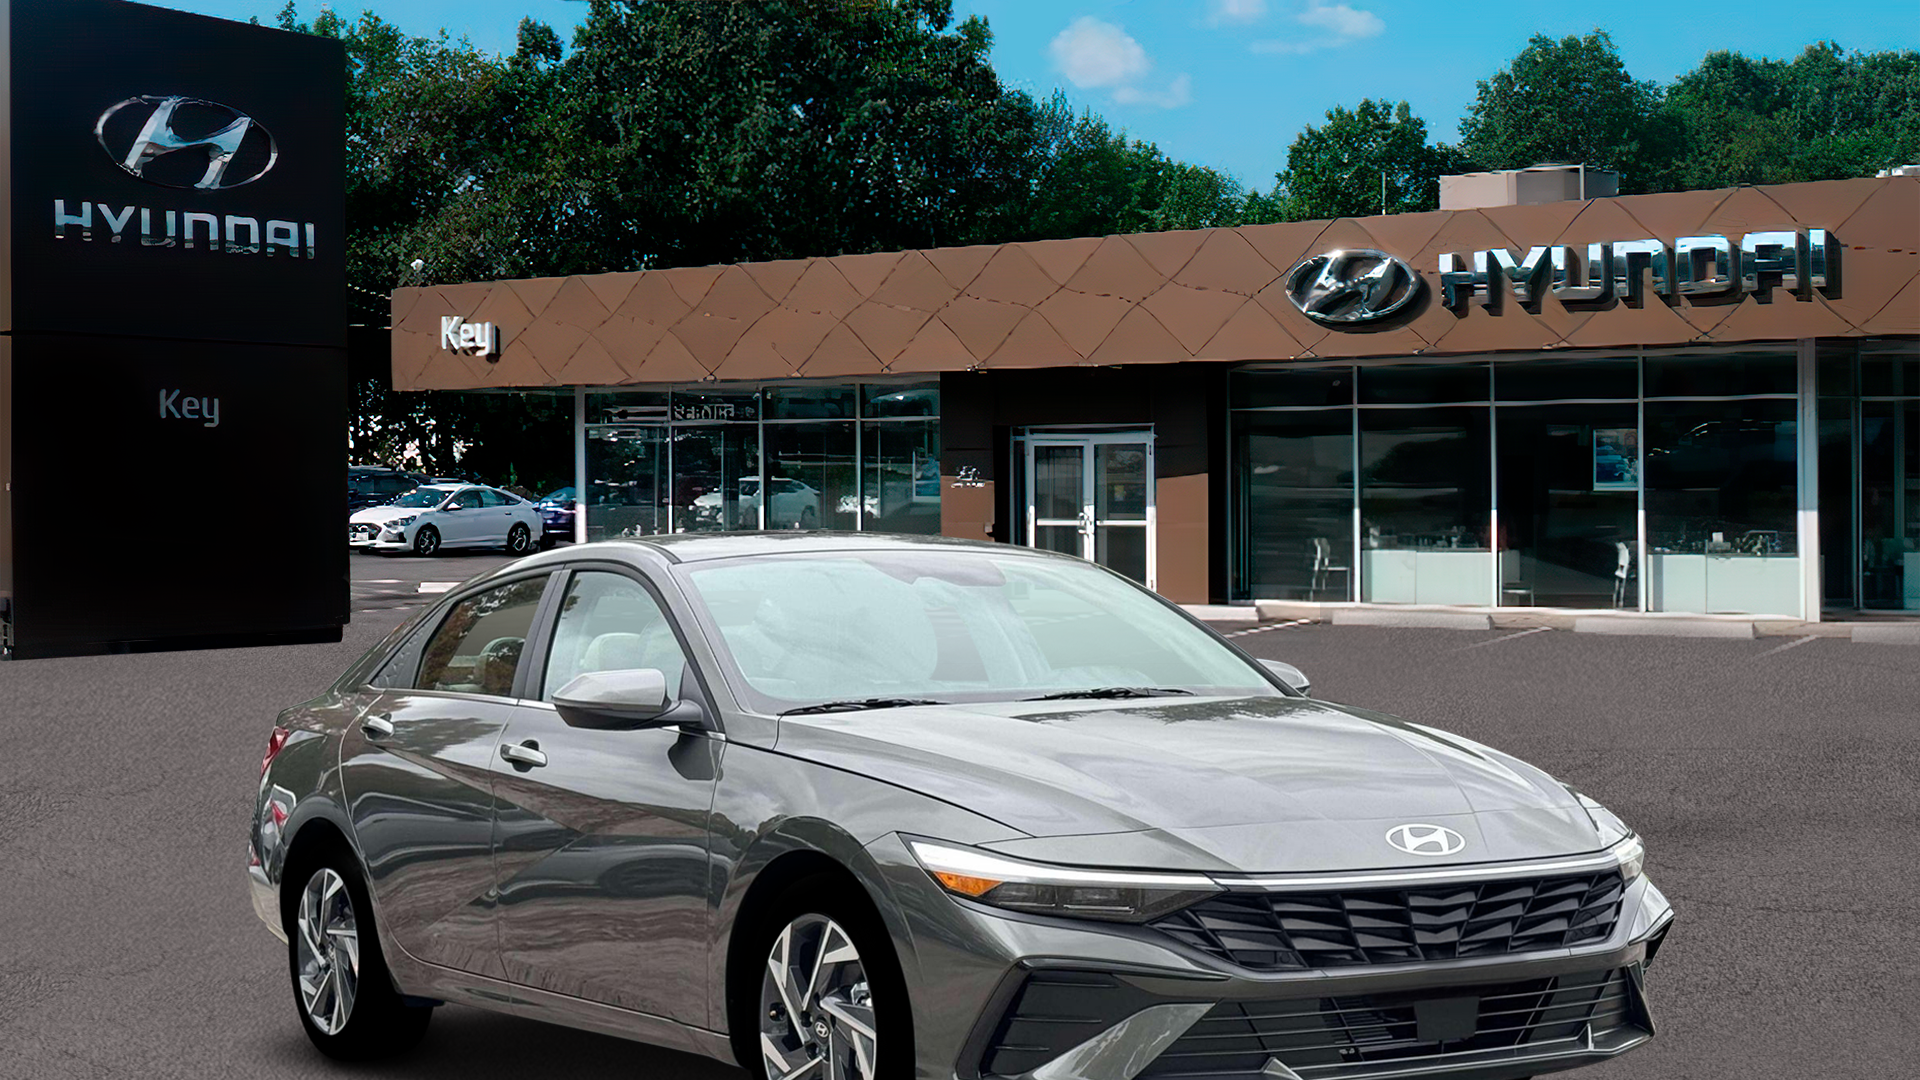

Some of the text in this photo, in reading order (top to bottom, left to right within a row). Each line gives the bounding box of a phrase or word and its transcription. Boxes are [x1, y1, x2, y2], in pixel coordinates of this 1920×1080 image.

[54, 199, 315, 259] HYUNDAI
[1438, 228, 1836, 308] HYUNDAI
[441, 315, 492, 357] Key
[159, 388, 219, 427] Key
